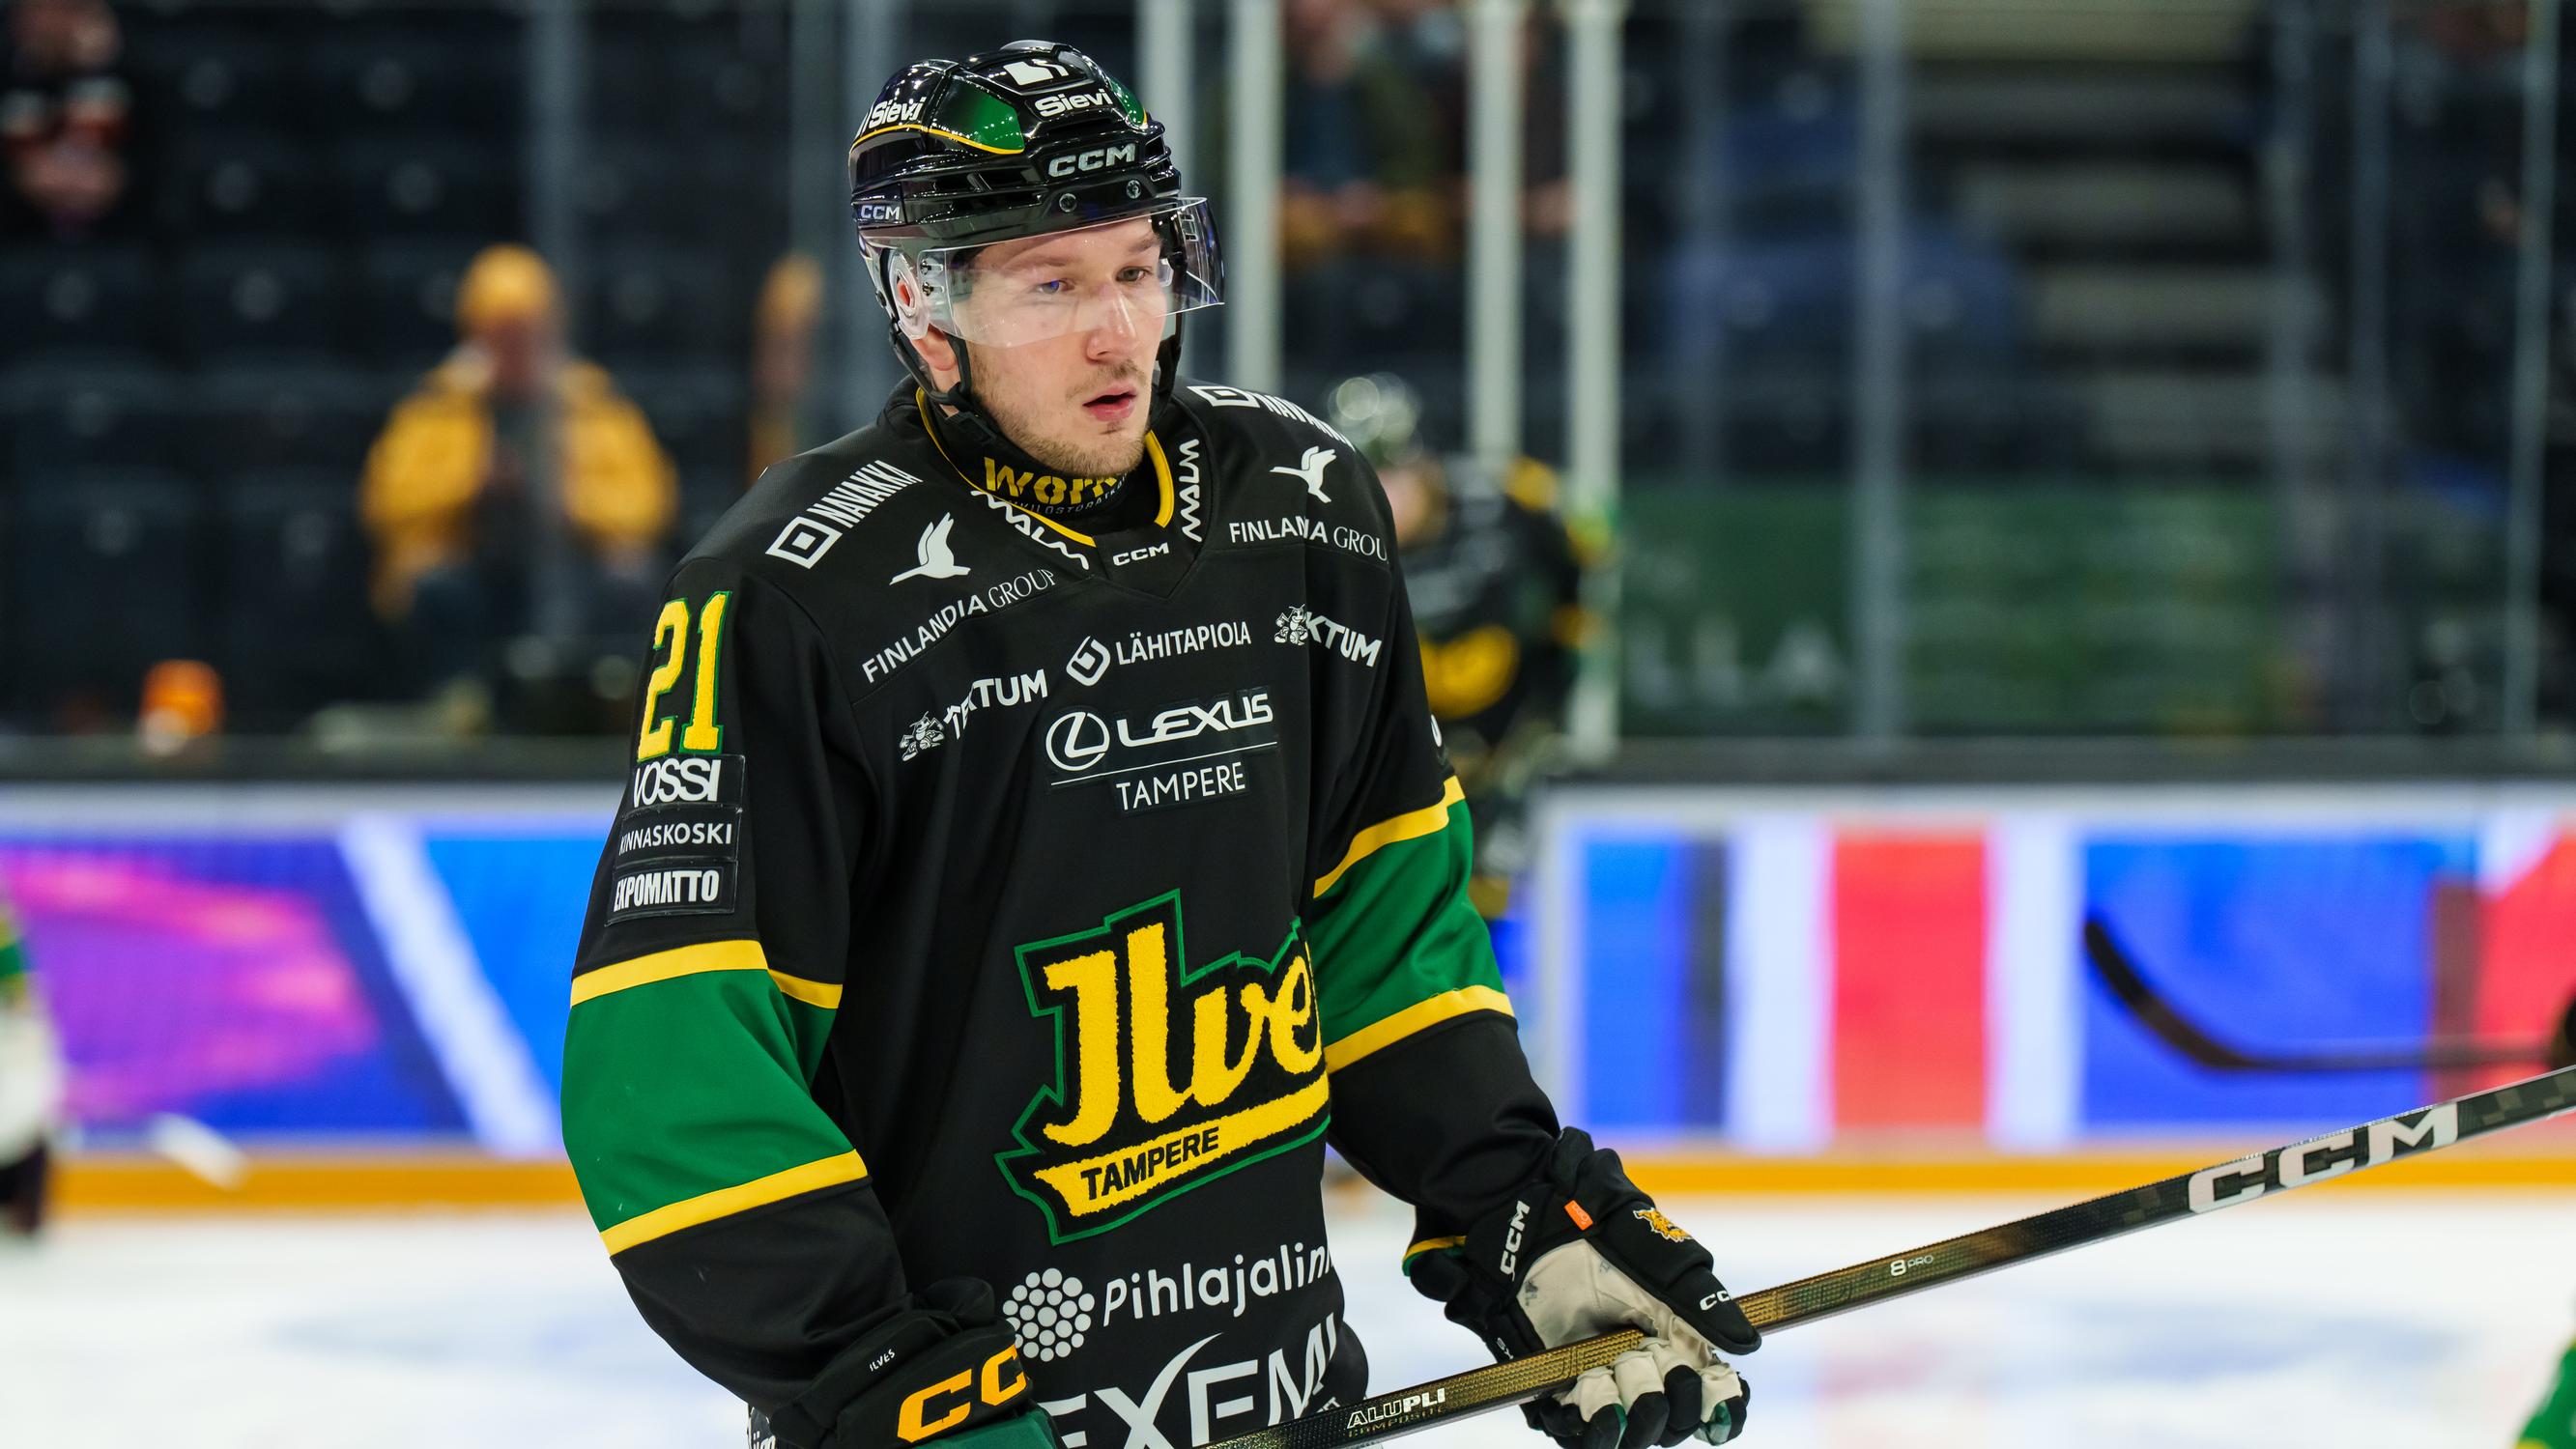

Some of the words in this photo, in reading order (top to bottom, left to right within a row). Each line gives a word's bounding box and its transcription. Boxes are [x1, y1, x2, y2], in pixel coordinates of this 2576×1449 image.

[869, 97, 928, 128] Sievi
[1035, 88, 1113, 118] Sievi
[1048, 144, 1137, 178] CCM
[860, 205, 901, 220] CCM
[806, 459, 924, 528] NAVAKKA
[1112, 542, 1170, 567] CCM
[1332, 526, 1389, 565] GROU
[862, 594, 988, 684] FINLANDIA
[987, 568, 1056, 609] GROUP
[1115, 620, 1252, 666] LÄHITAPIOLA
[1305, 611, 1383, 668] KTUM
[637, 590, 733, 763] 21
[1117, 693, 1274, 748] LEXUS
[633, 757, 722, 808] VOSSI
[1115, 761, 1246, 810] TAMPERE
[613, 869, 720, 912] EXPOMATTO
[1080, 1126, 1220, 1201] TAMPERE
[2188, 1101, 2458, 1214] CCM
[1500, 1200, 1531, 1275] CCM
[1103, 1241, 1330, 1327] Pihlajalin
[1890, 1259, 1907, 1277] 8
[1907, 1255, 1933, 1268] PRO
[1699, 1290, 1731, 1311] CC
[869, 1349, 896, 1372] ILVES
[897, 1344, 1028, 1443] CC
[1346, 1387, 1446, 1430] ALUPLI
